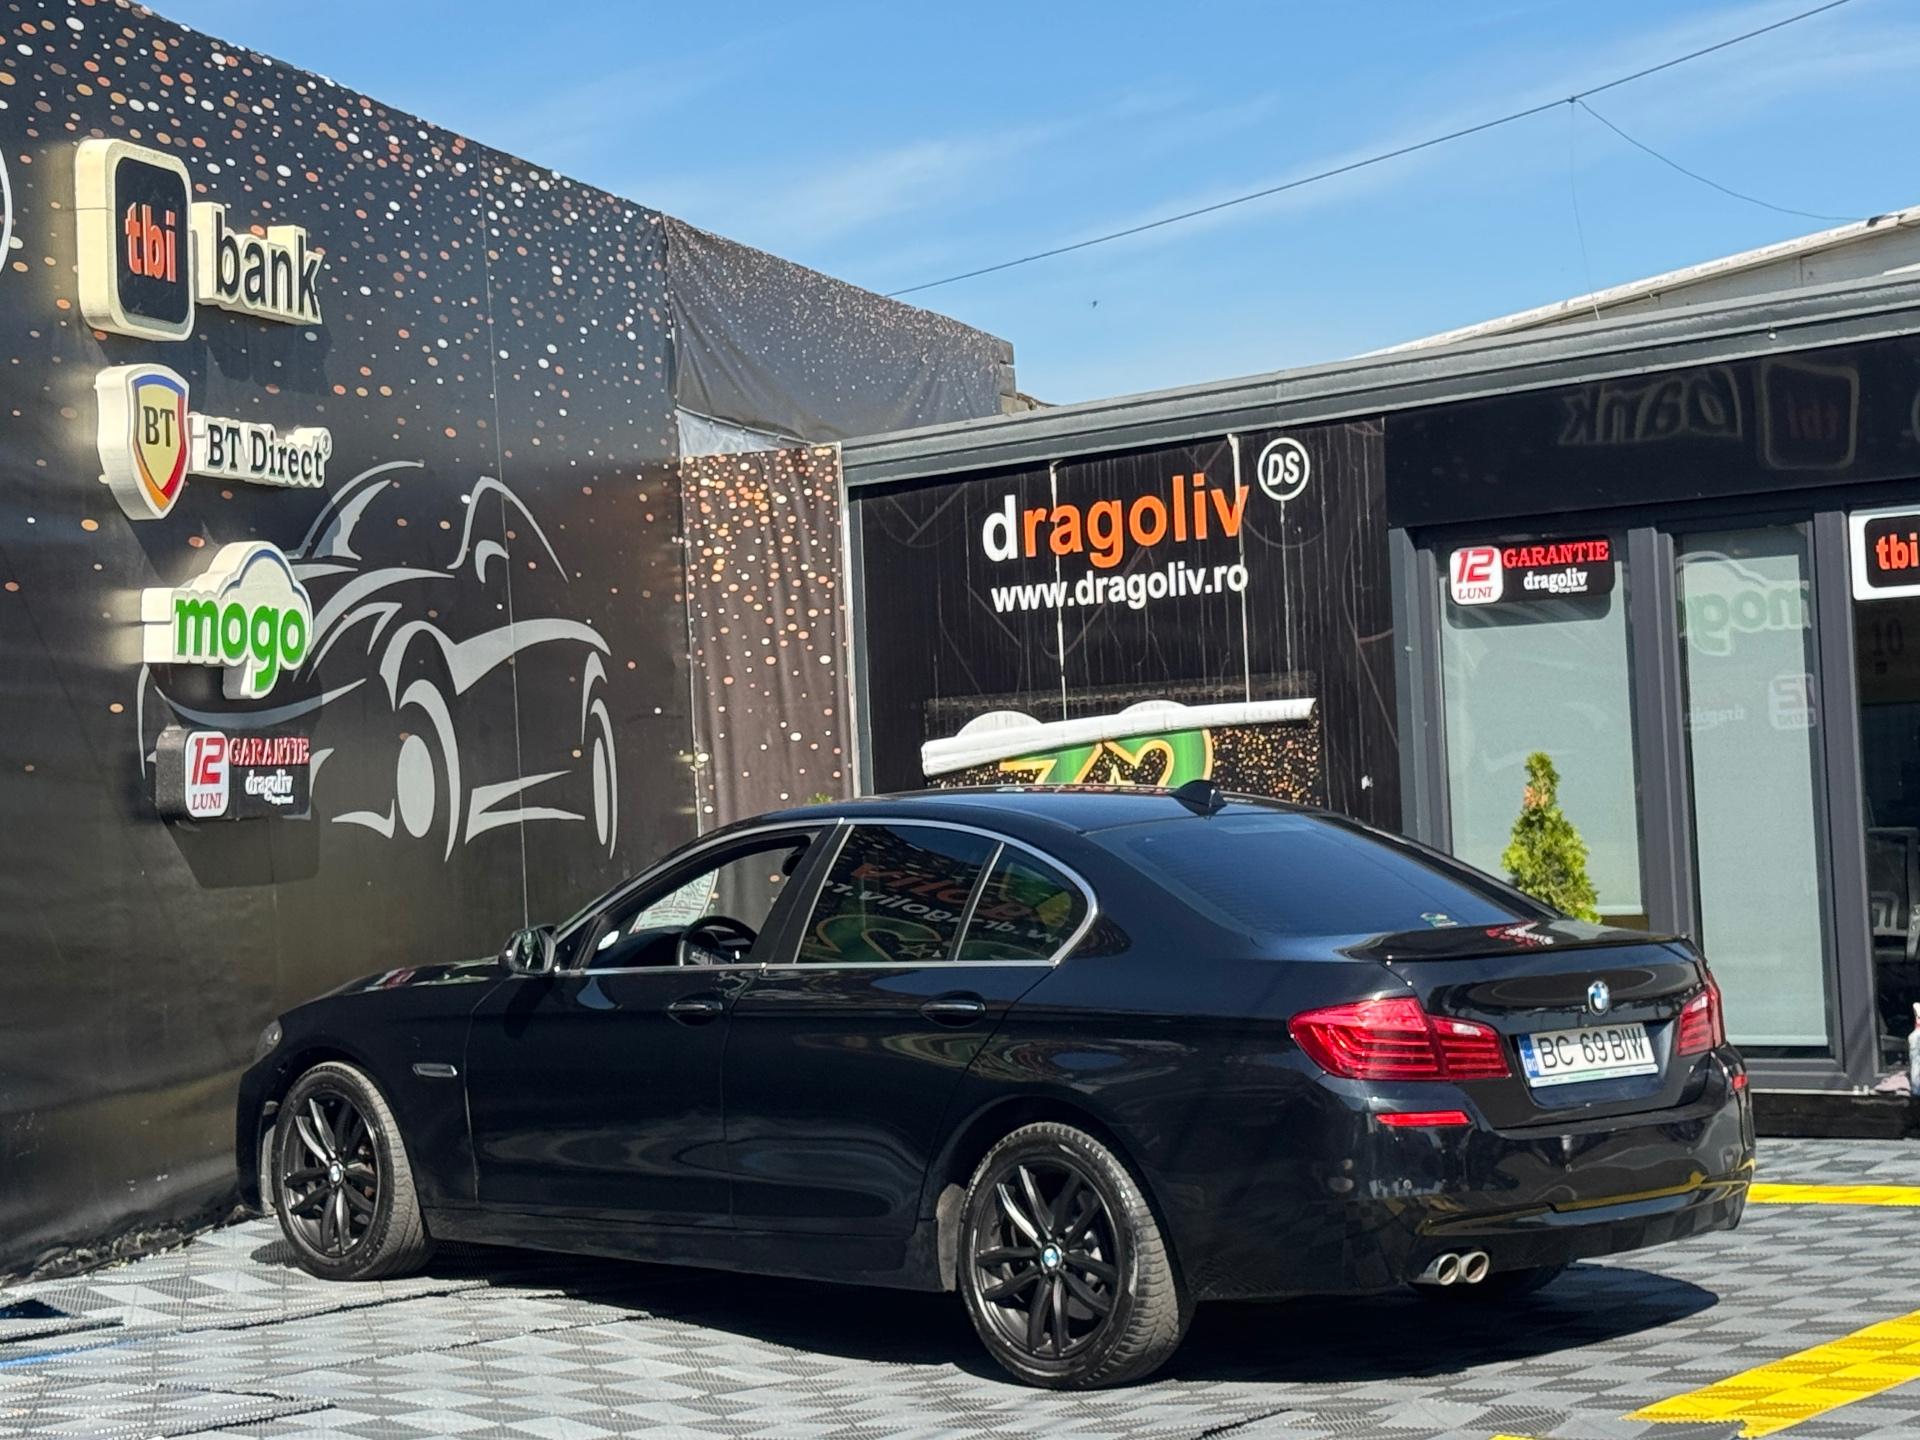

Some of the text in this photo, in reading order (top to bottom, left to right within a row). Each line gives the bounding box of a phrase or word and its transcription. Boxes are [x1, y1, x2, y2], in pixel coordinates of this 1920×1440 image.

[125, 202, 321, 317] tbi bank
[143, 406, 175, 447] BT
[207, 424, 323, 482] BT Direct
[1267, 450, 1300, 487] DS
[982, 472, 1250, 569] dragoliv
[1456, 547, 1495, 583] 12
[1503, 540, 1609, 569] GARANTIE
[1876, 532, 1919, 570] tbi
[991, 561, 1249, 613] www.dragoliv.ro
[1458, 586, 1493, 600] LUNI
[1523, 567, 1588, 593] dragoliv
[175, 598, 307, 692] mogo
[191, 738, 226, 785] 12
[228, 737, 310, 766] GARANTIE
[192, 793, 222, 811] LUNI
[245, 769, 293, 801] dragoliv
[1537, 1036, 1574, 1069] BC
[1580, 1031, 1608, 1064] 69
[1608, 1027, 1646, 1061] BIW
